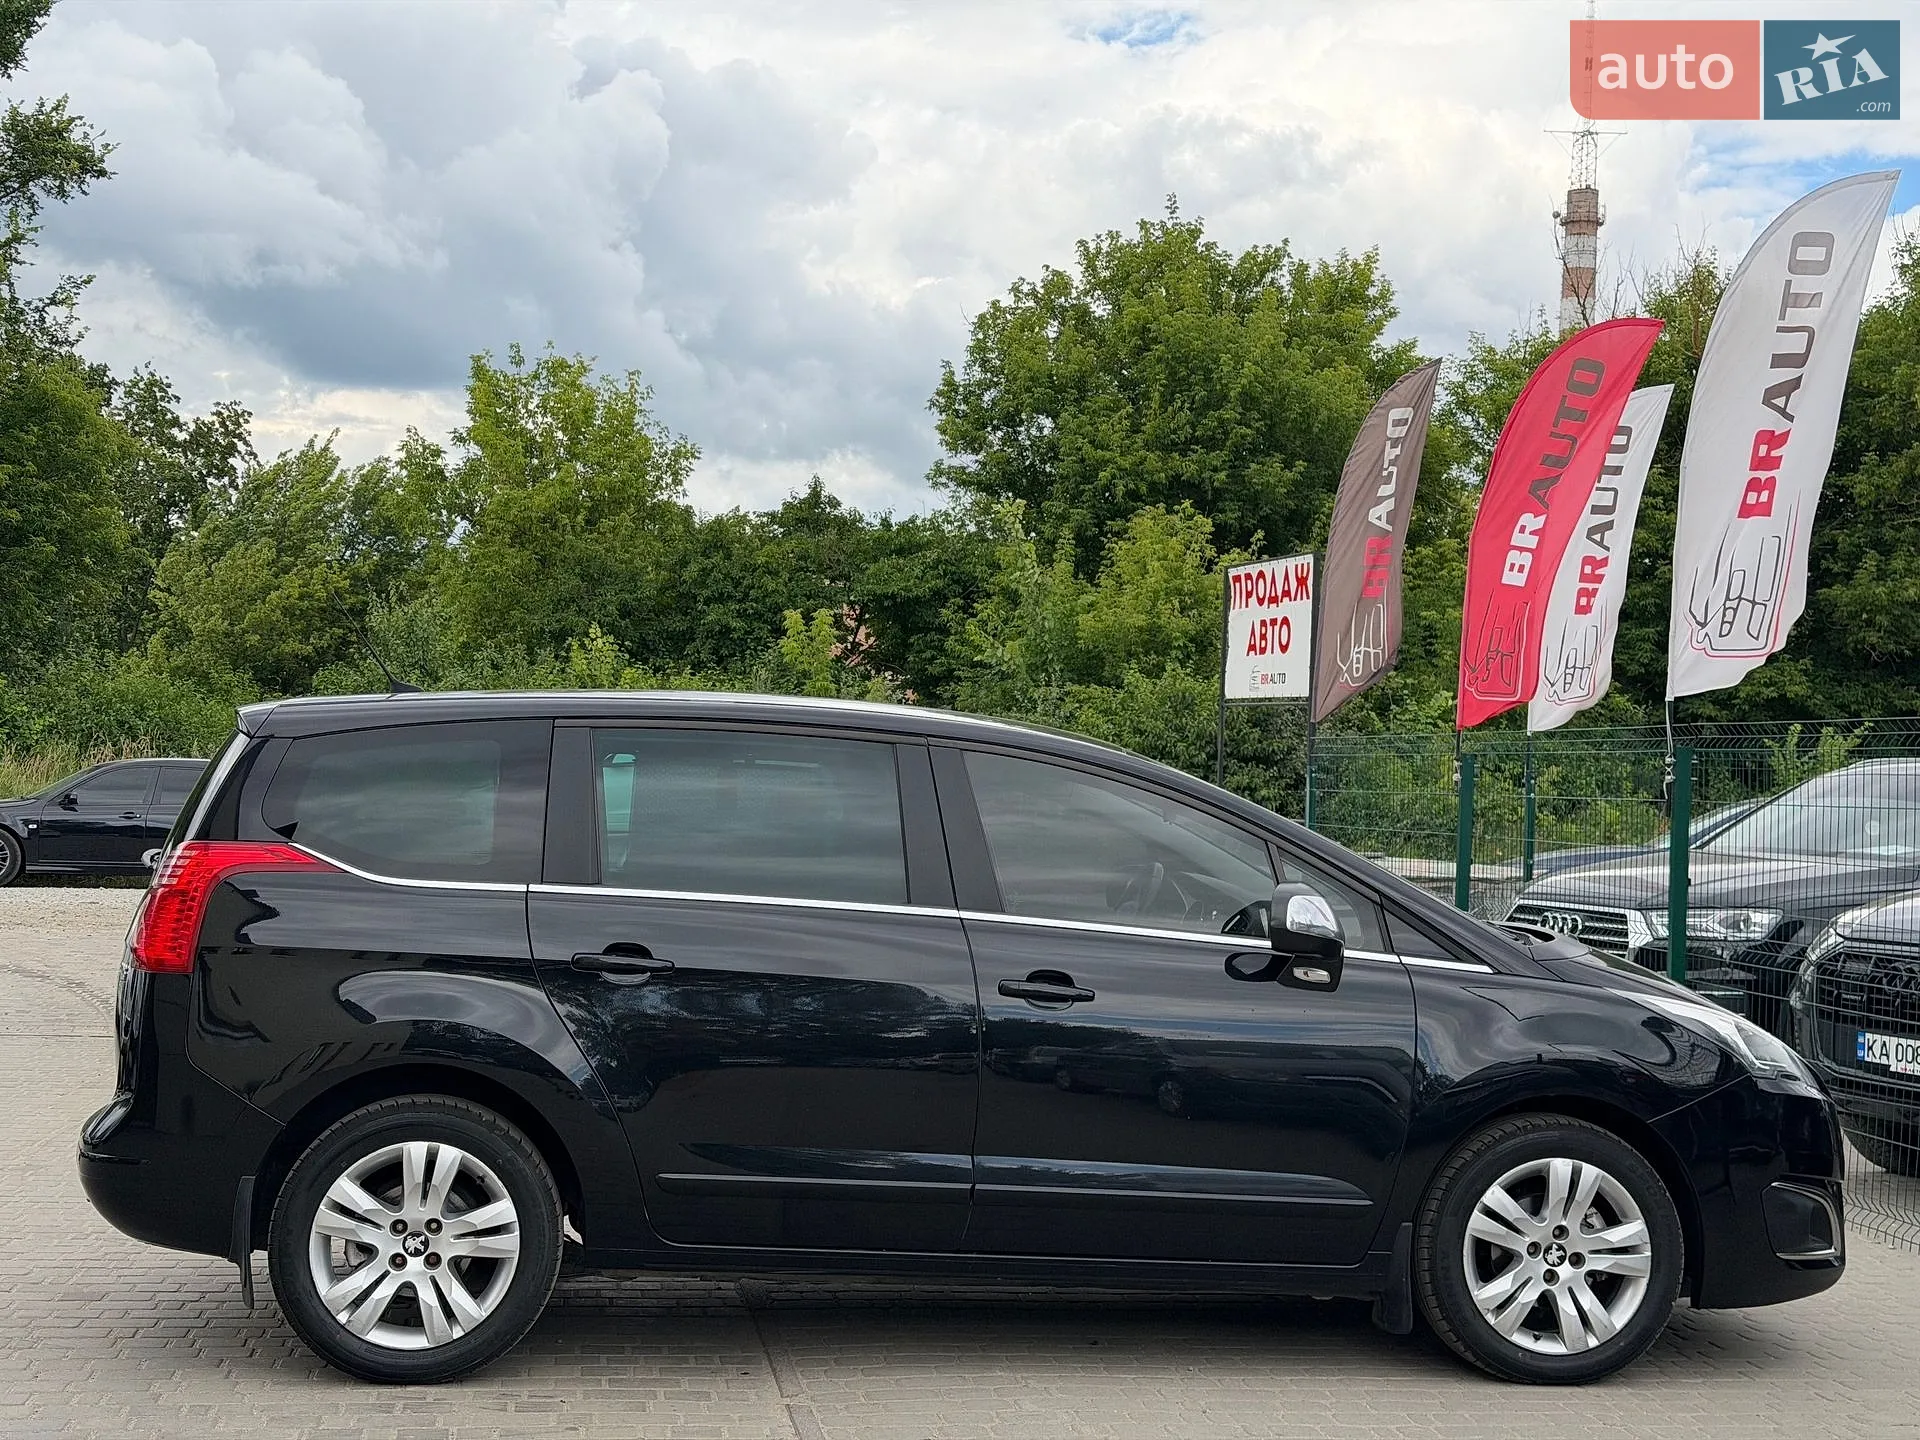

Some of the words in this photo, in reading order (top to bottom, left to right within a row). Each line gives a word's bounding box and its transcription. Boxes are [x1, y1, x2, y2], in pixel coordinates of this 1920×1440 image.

[1231, 562, 1311, 610] ПРОДАЖ
[1246, 615, 1292, 657] АВТО
[1866, 1037, 1890, 1061] KA
